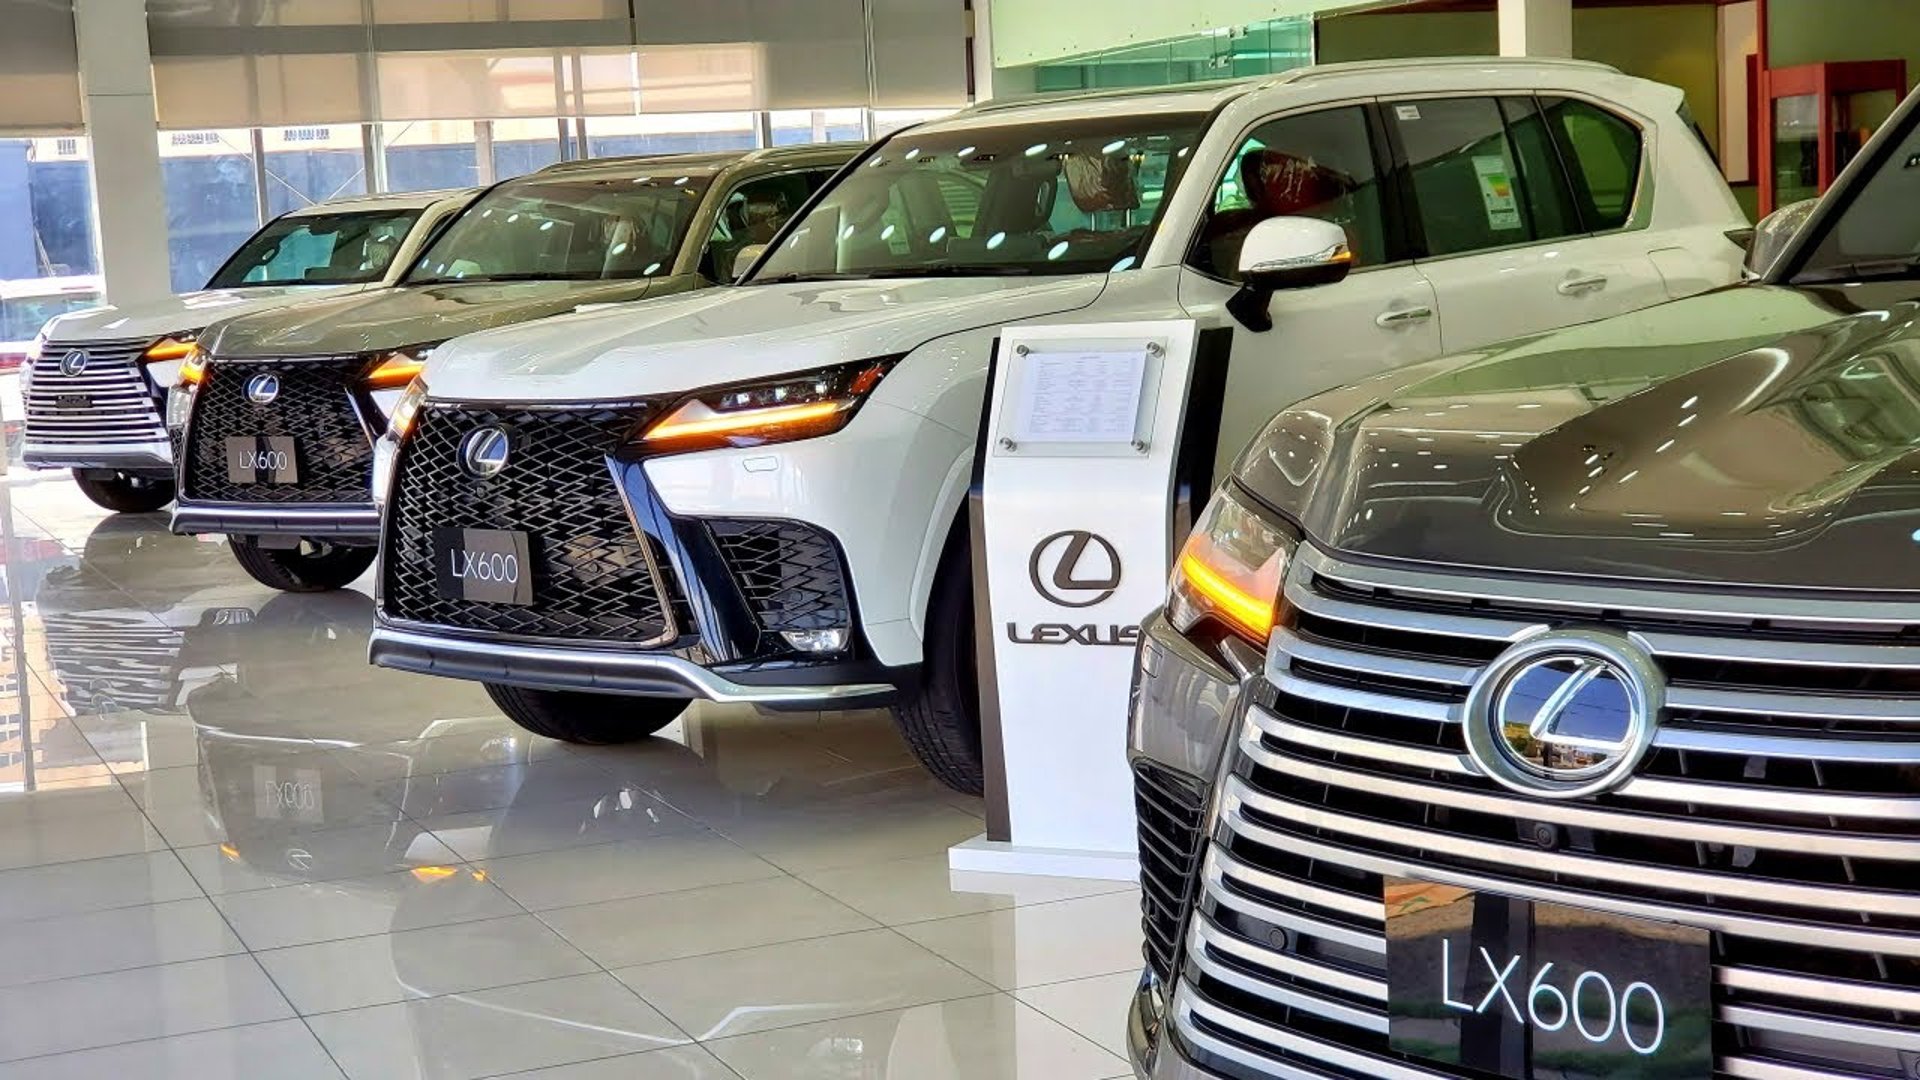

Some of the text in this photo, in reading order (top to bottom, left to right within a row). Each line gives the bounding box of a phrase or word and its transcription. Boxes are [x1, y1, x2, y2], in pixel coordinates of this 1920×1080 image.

[239, 450, 288, 471] LX600
[450, 548, 519, 584] LX600
[1006, 622, 1140, 646] LEXUS
[1442, 938, 1665, 1055] LX600
